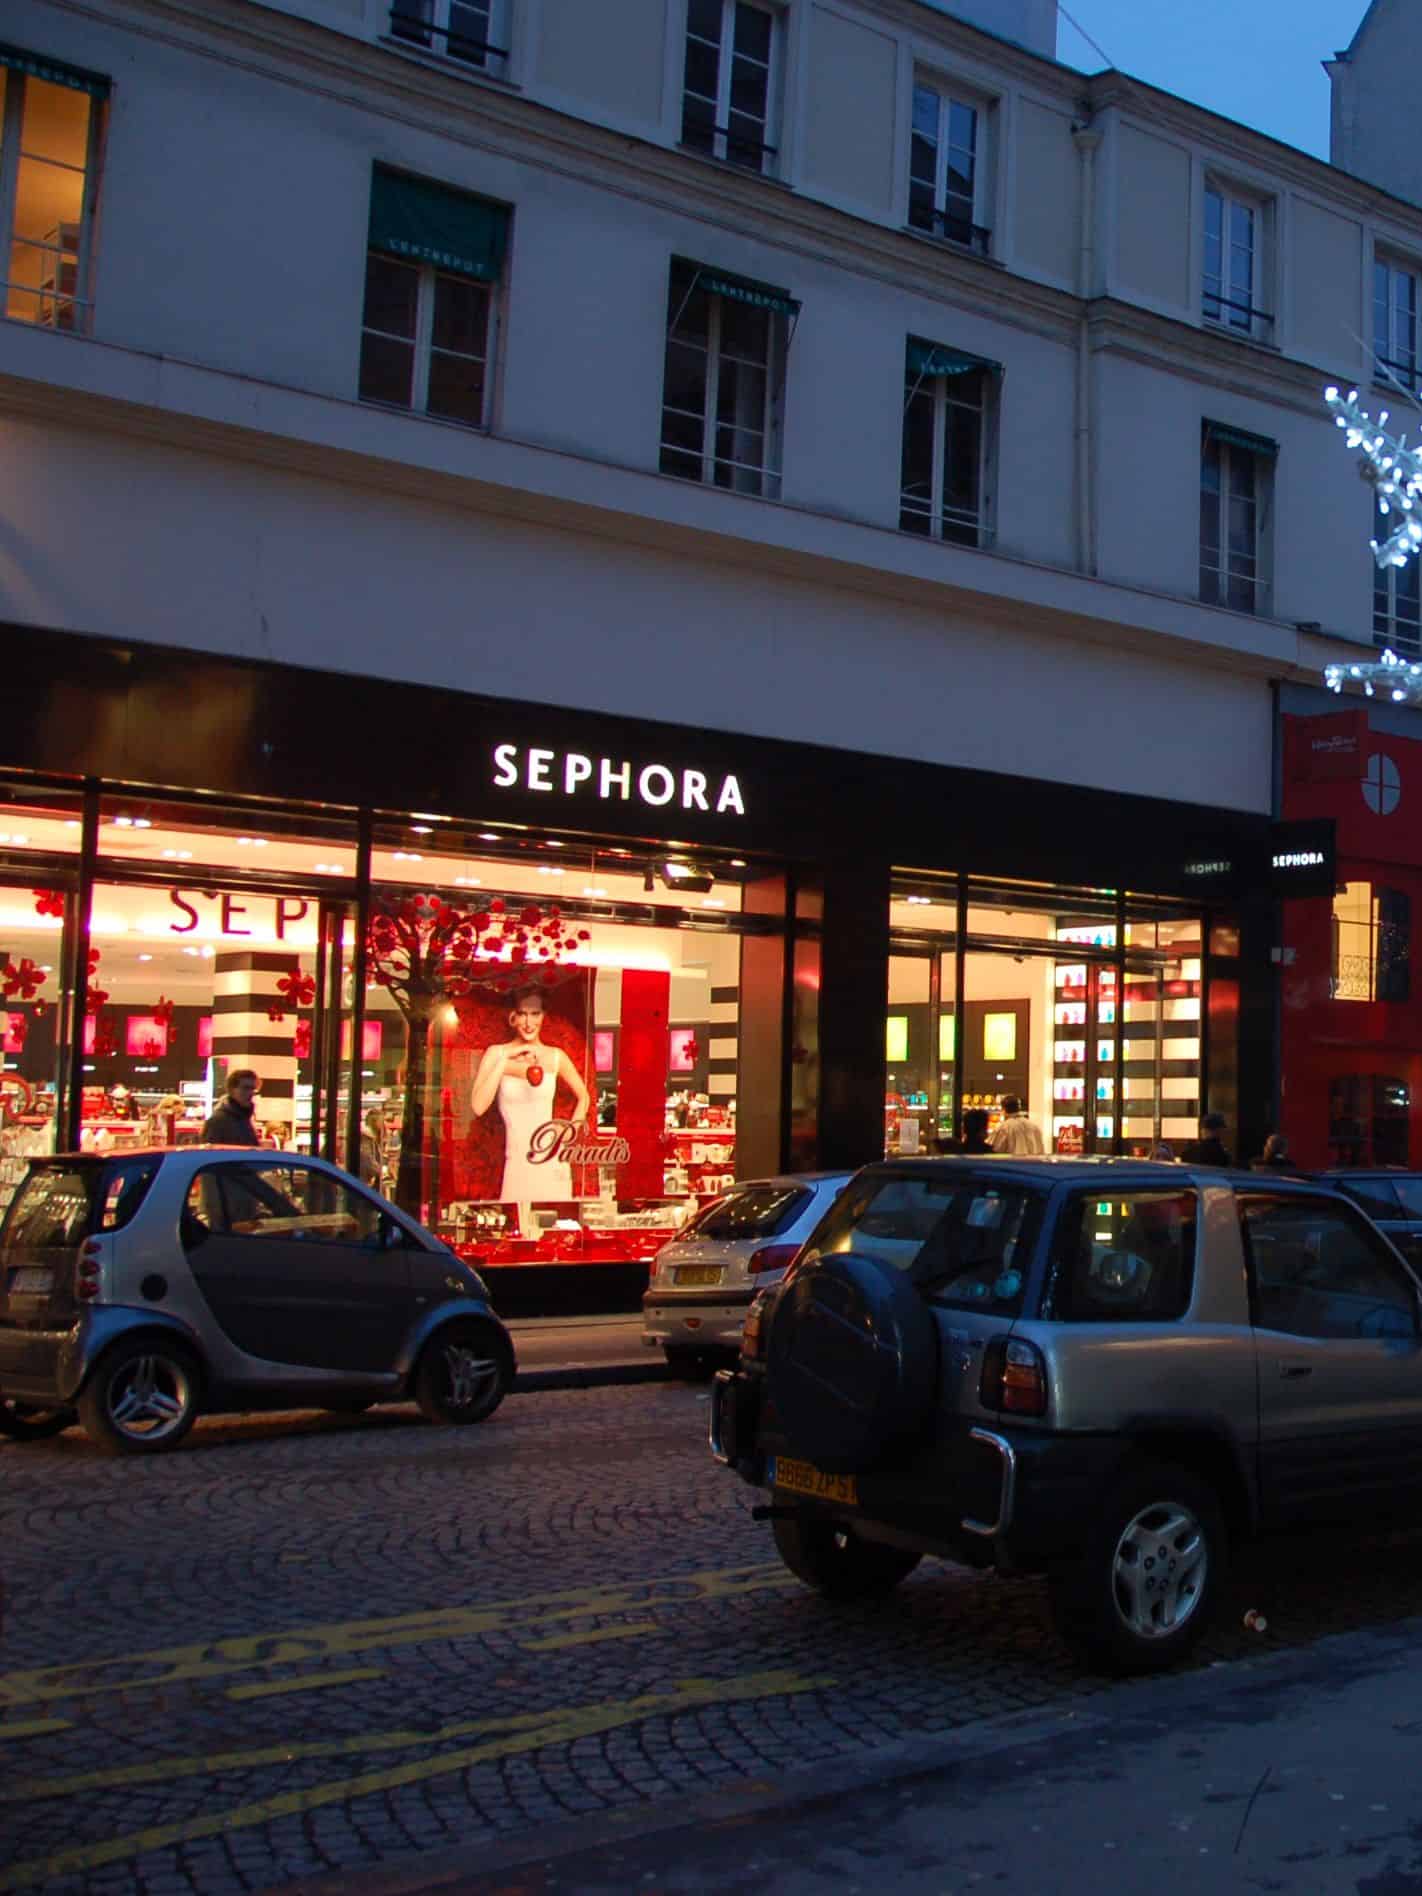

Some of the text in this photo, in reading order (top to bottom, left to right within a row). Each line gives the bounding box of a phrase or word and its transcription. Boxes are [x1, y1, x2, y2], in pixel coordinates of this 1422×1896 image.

[493, 743, 745, 815] SEPHORA
[1271, 852, 1325, 869] SEPHORA
[526, 1119, 632, 1165] Paradis
